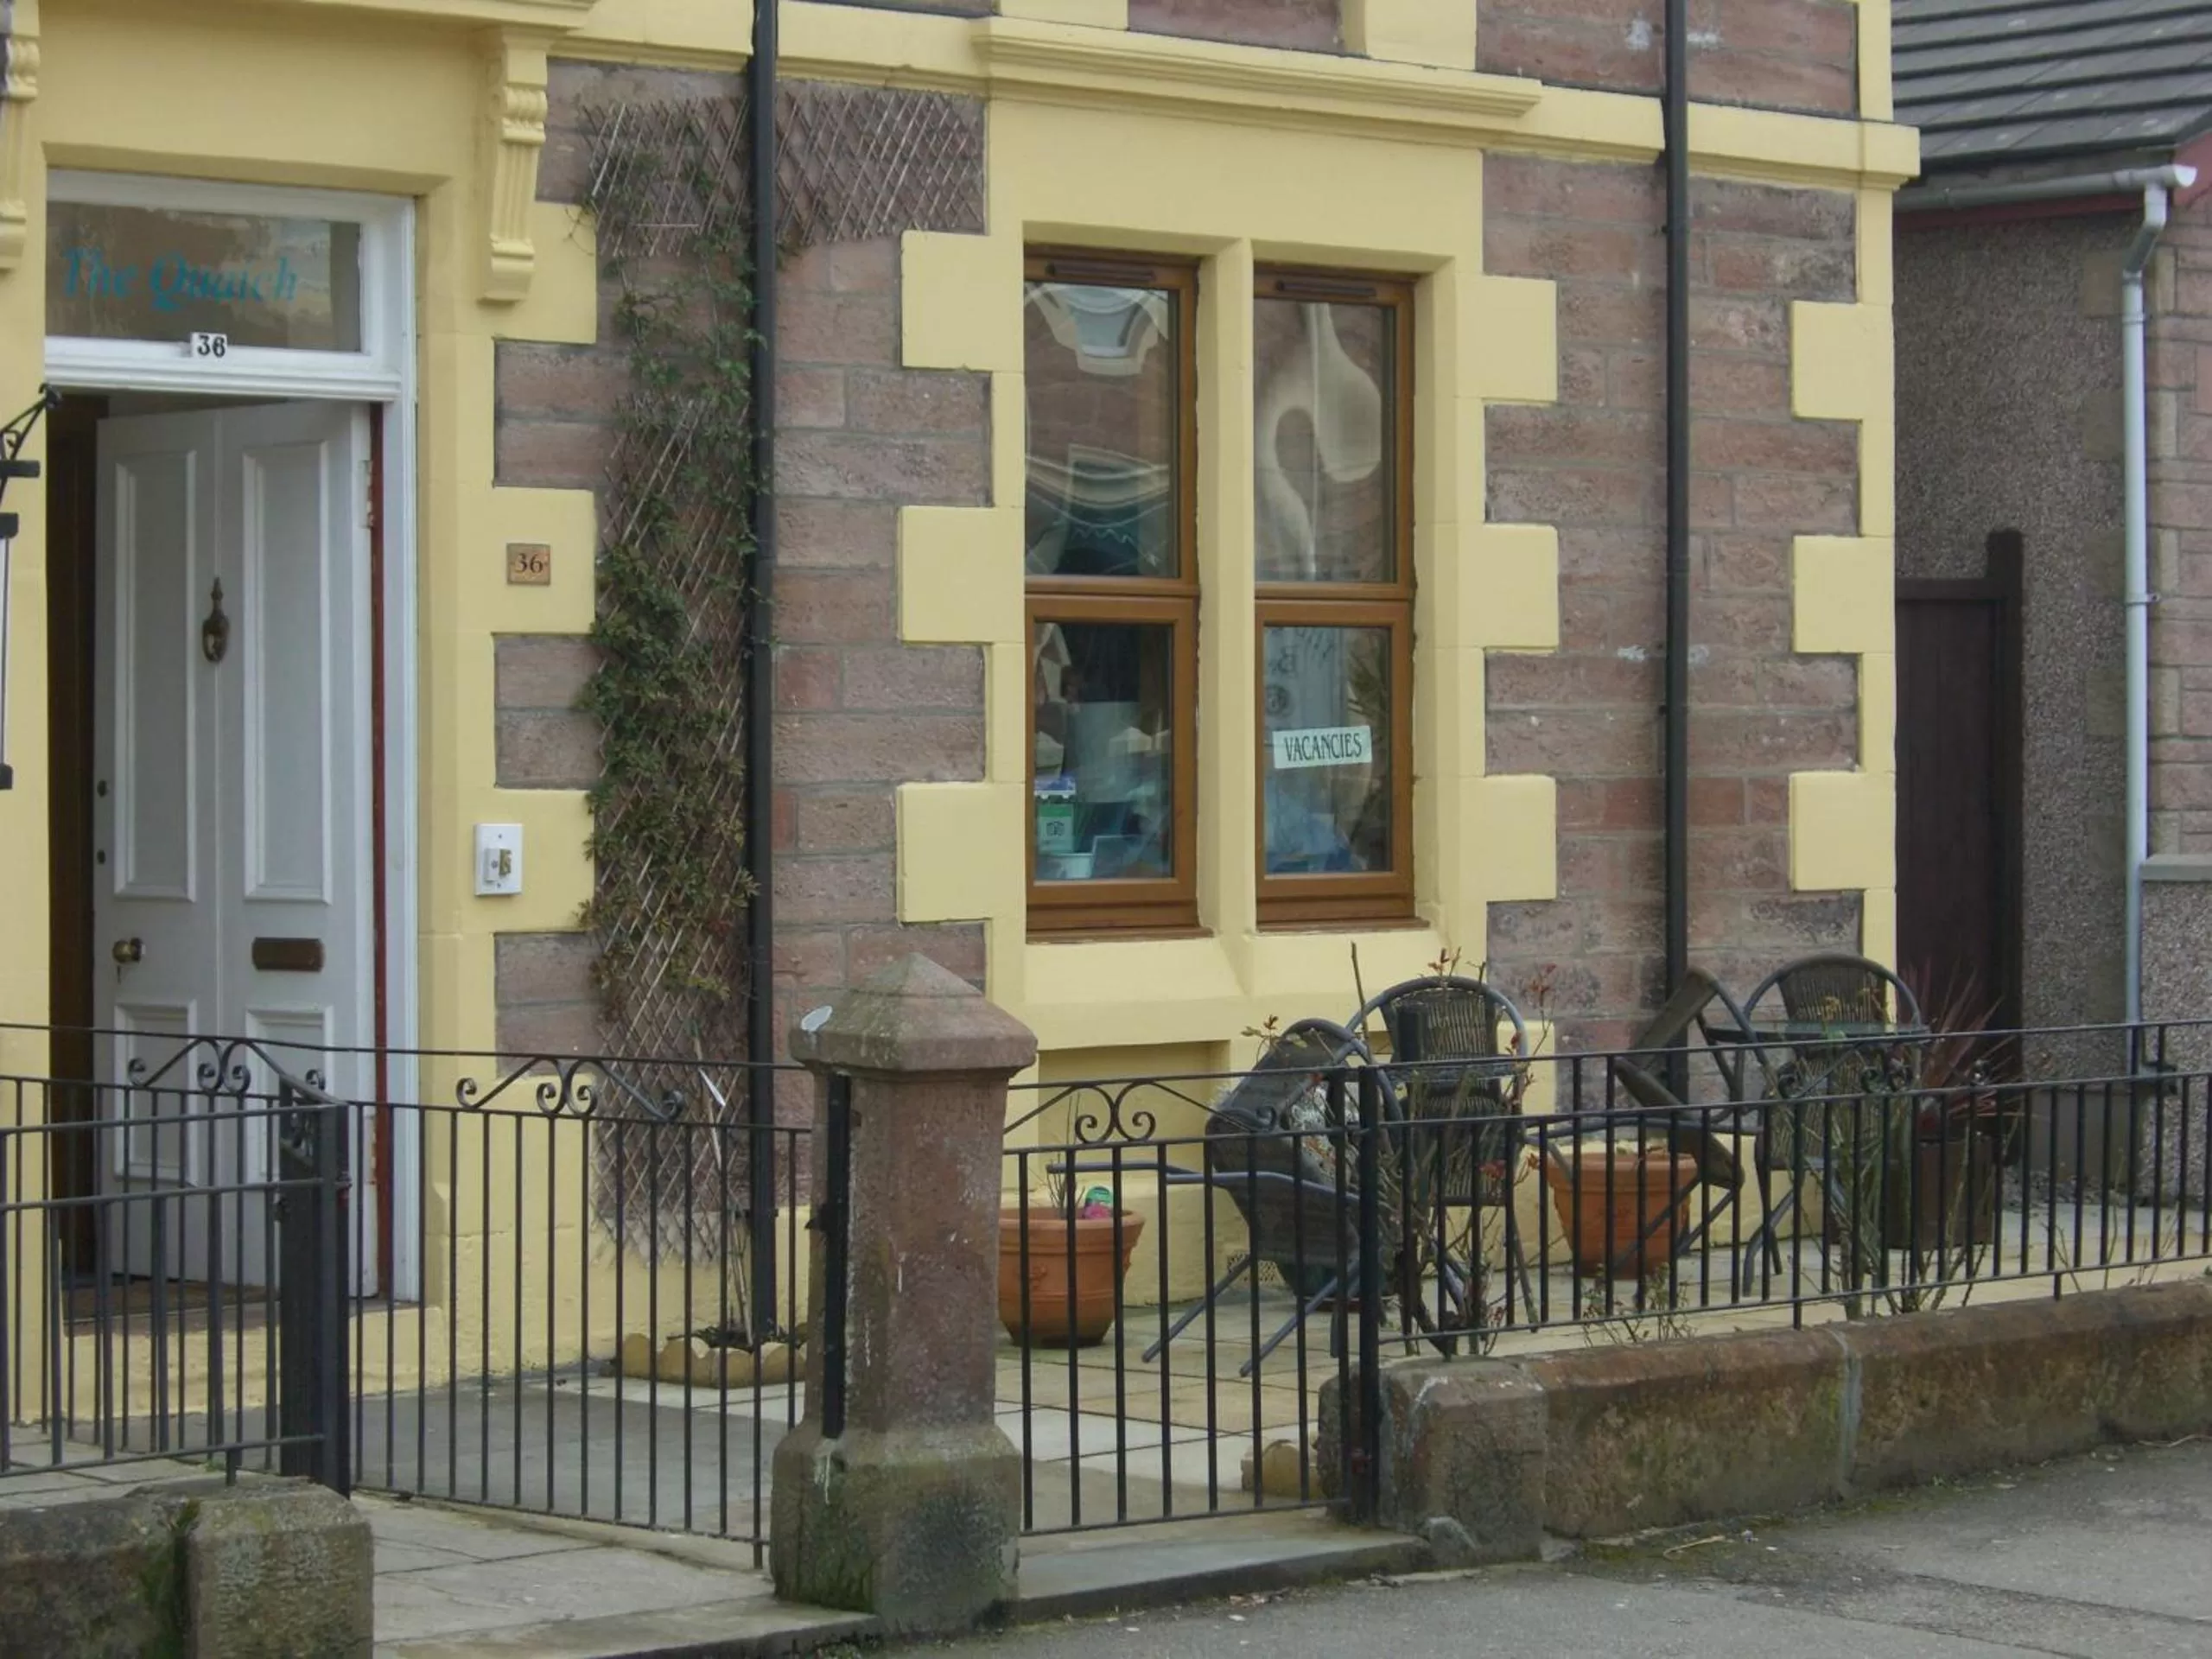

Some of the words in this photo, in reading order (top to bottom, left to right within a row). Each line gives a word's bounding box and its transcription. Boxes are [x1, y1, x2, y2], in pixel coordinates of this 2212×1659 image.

[63, 246, 137, 297] The
[149, 251, 298, 312] Quaich
[197, 334, 226, 357] 36
[514, 553, 543, 574] 36
[1284, 733, 1363, 762] VACANCIES
